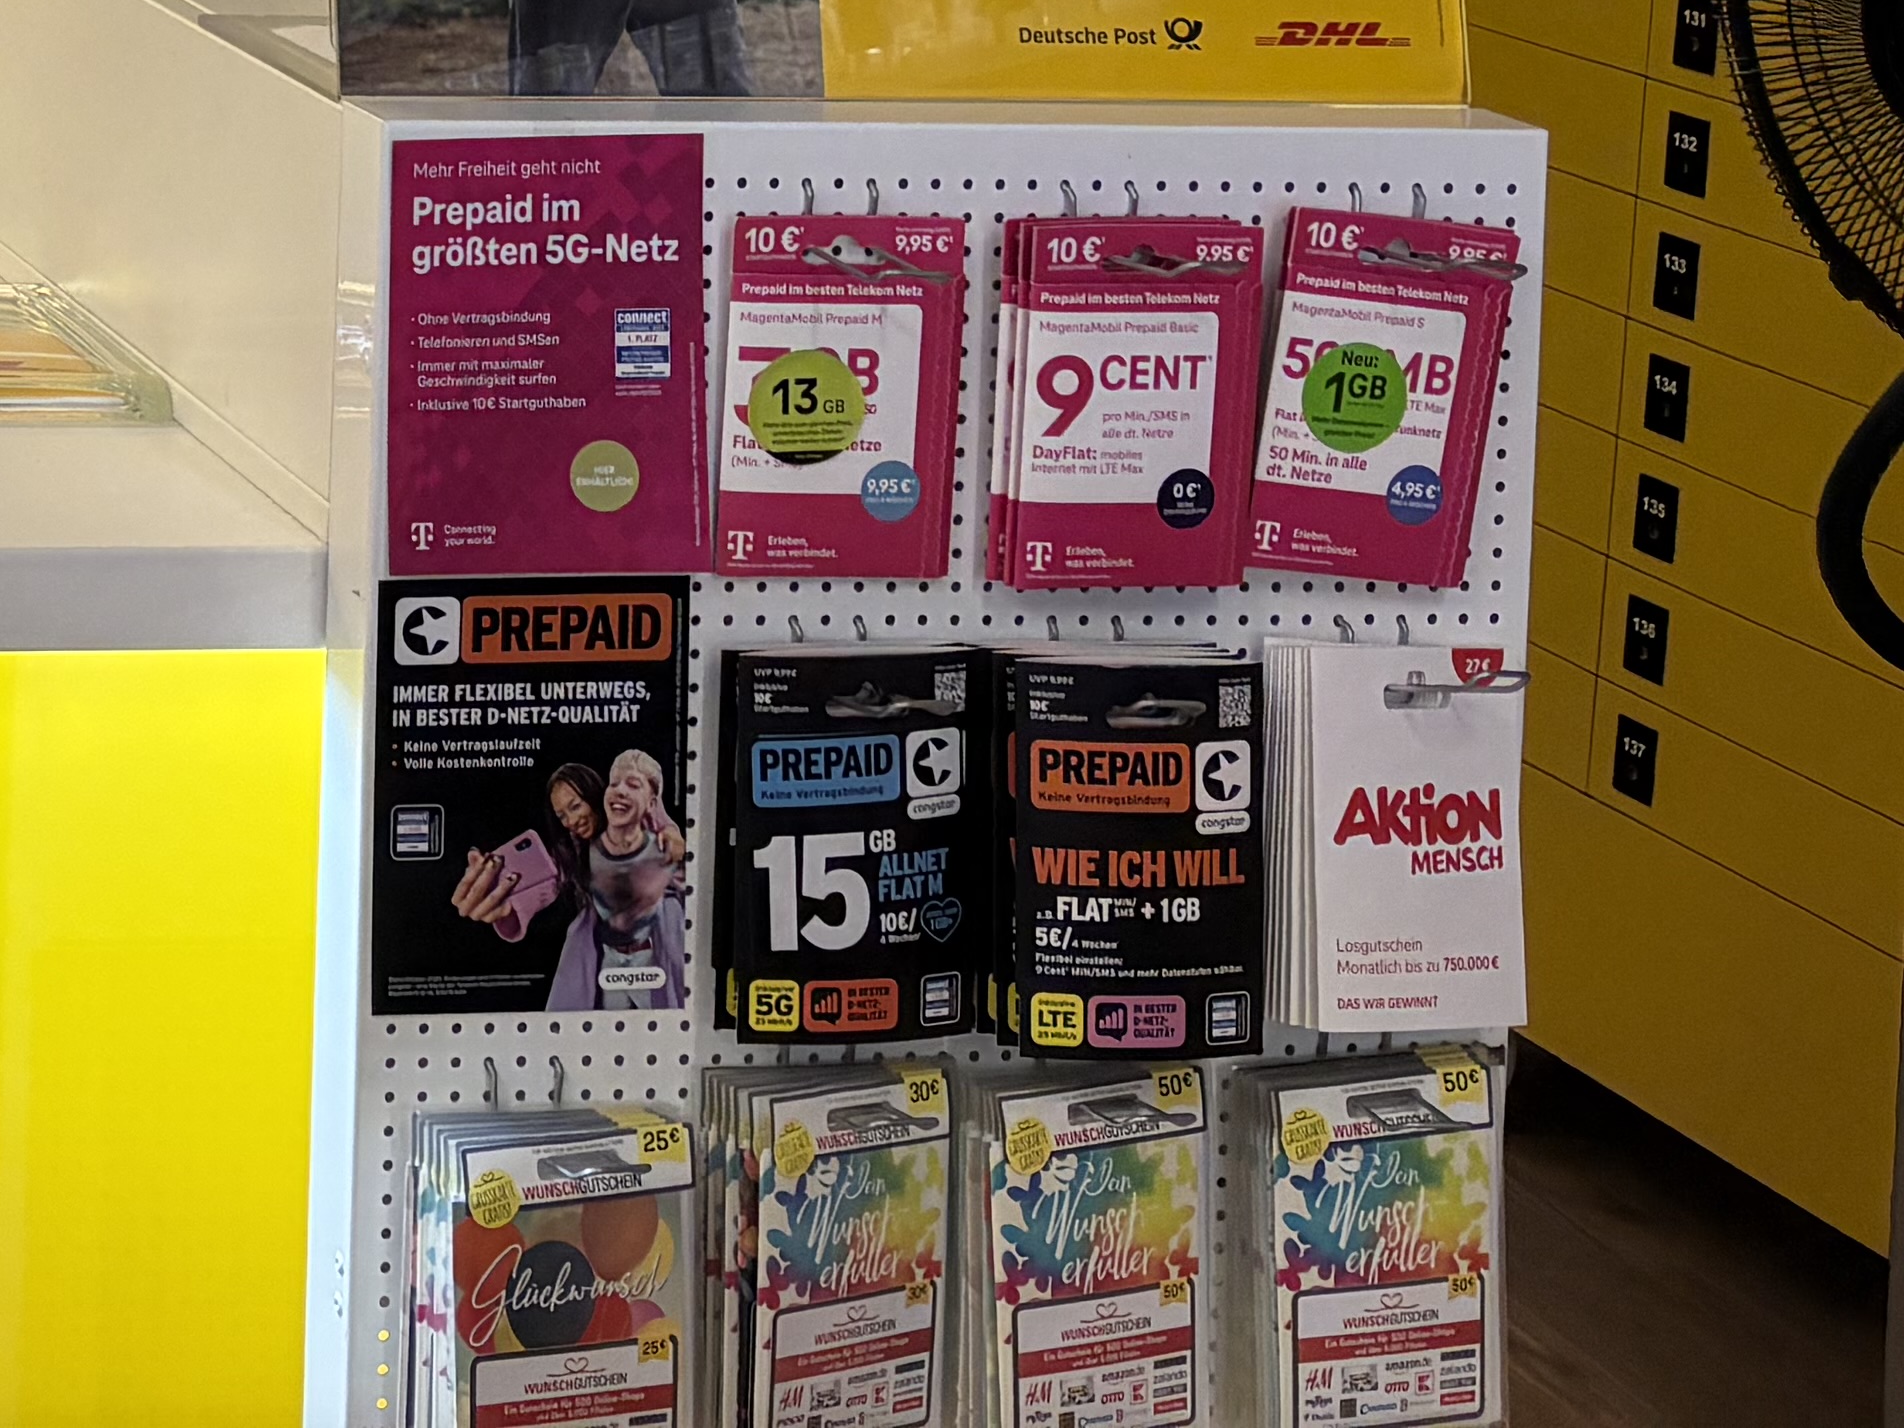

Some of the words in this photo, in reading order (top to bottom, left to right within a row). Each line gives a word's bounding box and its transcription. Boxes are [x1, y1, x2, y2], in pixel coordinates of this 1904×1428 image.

[1683, 8, 1706, 28] 131
[1018, 26, 1108, 46] Deutsche
[1113, 26, 1157, 46] Post
[1275, 21, 1392, 48] DHL
[413, 161, 454, 178] Mehr
[458, 160, 516, 177] Freiheit
[520, 160, 557, 179] geht
[560, 158, 601, 176] nicht
[413, 195, 533, 229] Prepaid
[542, 197, 580, 222] im
[412, 236, 538, 273] größten
[545, 233, 679, 264] 5G-Netz
[1664, 253, 1688, 273] 133
[1342, 350, 1379, 370] Neu:
[772, 378, 818, 416] 13
[823, 400, 845, 414] GB
[1036, 354, 1094, 437] 9
[1100, 355, 1206, 390] CENT
[1642, 496, 1667, 517] 135
[393, 684, 450, 703] IMMER
[454, 682, 535, 702] FLEXIBEL
[541, 681, 651, 701] UNTERWEGS,
[393, 709, 412, 727] IN
[417, 707, 482, 726] BESTER
[488, 702, 640, 724] D-NETZ-QUALITÄT
[1623, 735, 1647, 758] 137
[1032, 847, 1099, 886] WIE
[1108, 847, 1166, 886] ICH
[1174, 848, 1245, 886] WILL
[1411, 846, 1504, 875] MENSCH
[1336, 938, 1423, 956] Losgutschein
[1158, 1072, 1192, 1097] 50€
[643, 1130, 680, 1153] 25€
[470, 1244, 670, 1346] Glückwunsch
